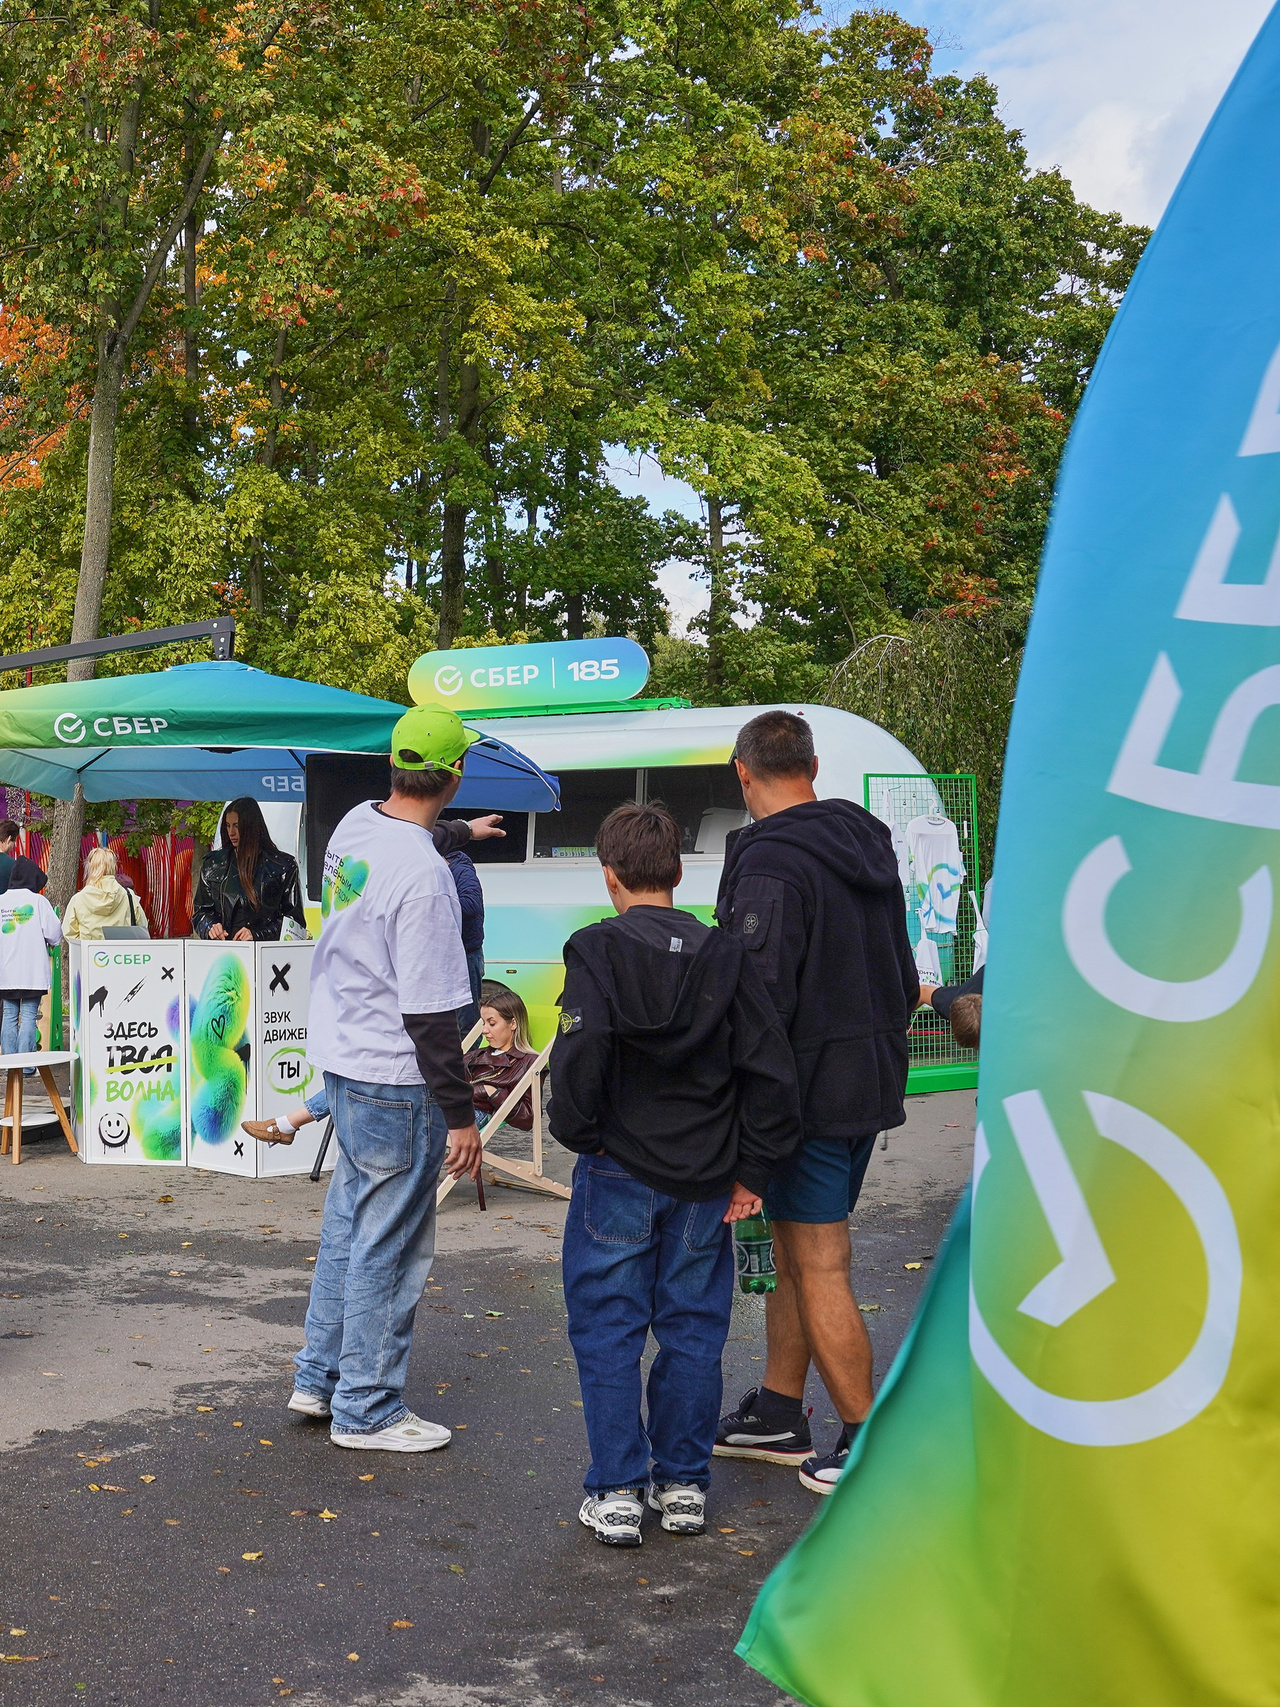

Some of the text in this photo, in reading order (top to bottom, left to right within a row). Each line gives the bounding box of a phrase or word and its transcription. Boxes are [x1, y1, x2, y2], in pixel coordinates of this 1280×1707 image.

[470, 659, 620, 688] СБЕР 185
[1062, 340, 1280, 1022] СБЕ
[93, 716, 169, 738] СБЕР
[325, 849, 345, 868] ыть
[113, 953, 152, 966] СБЕР
[263, 1010, 292, 1024] ЗВУК
[103, 1021, 159, 1041] ЗДЕСЬ
[105, 1044, 174, 1075] ТВОЯ
[277, 1060, 301, 1080] ТЫ
[105, 1079, 176, 1103] ВОЛНА
